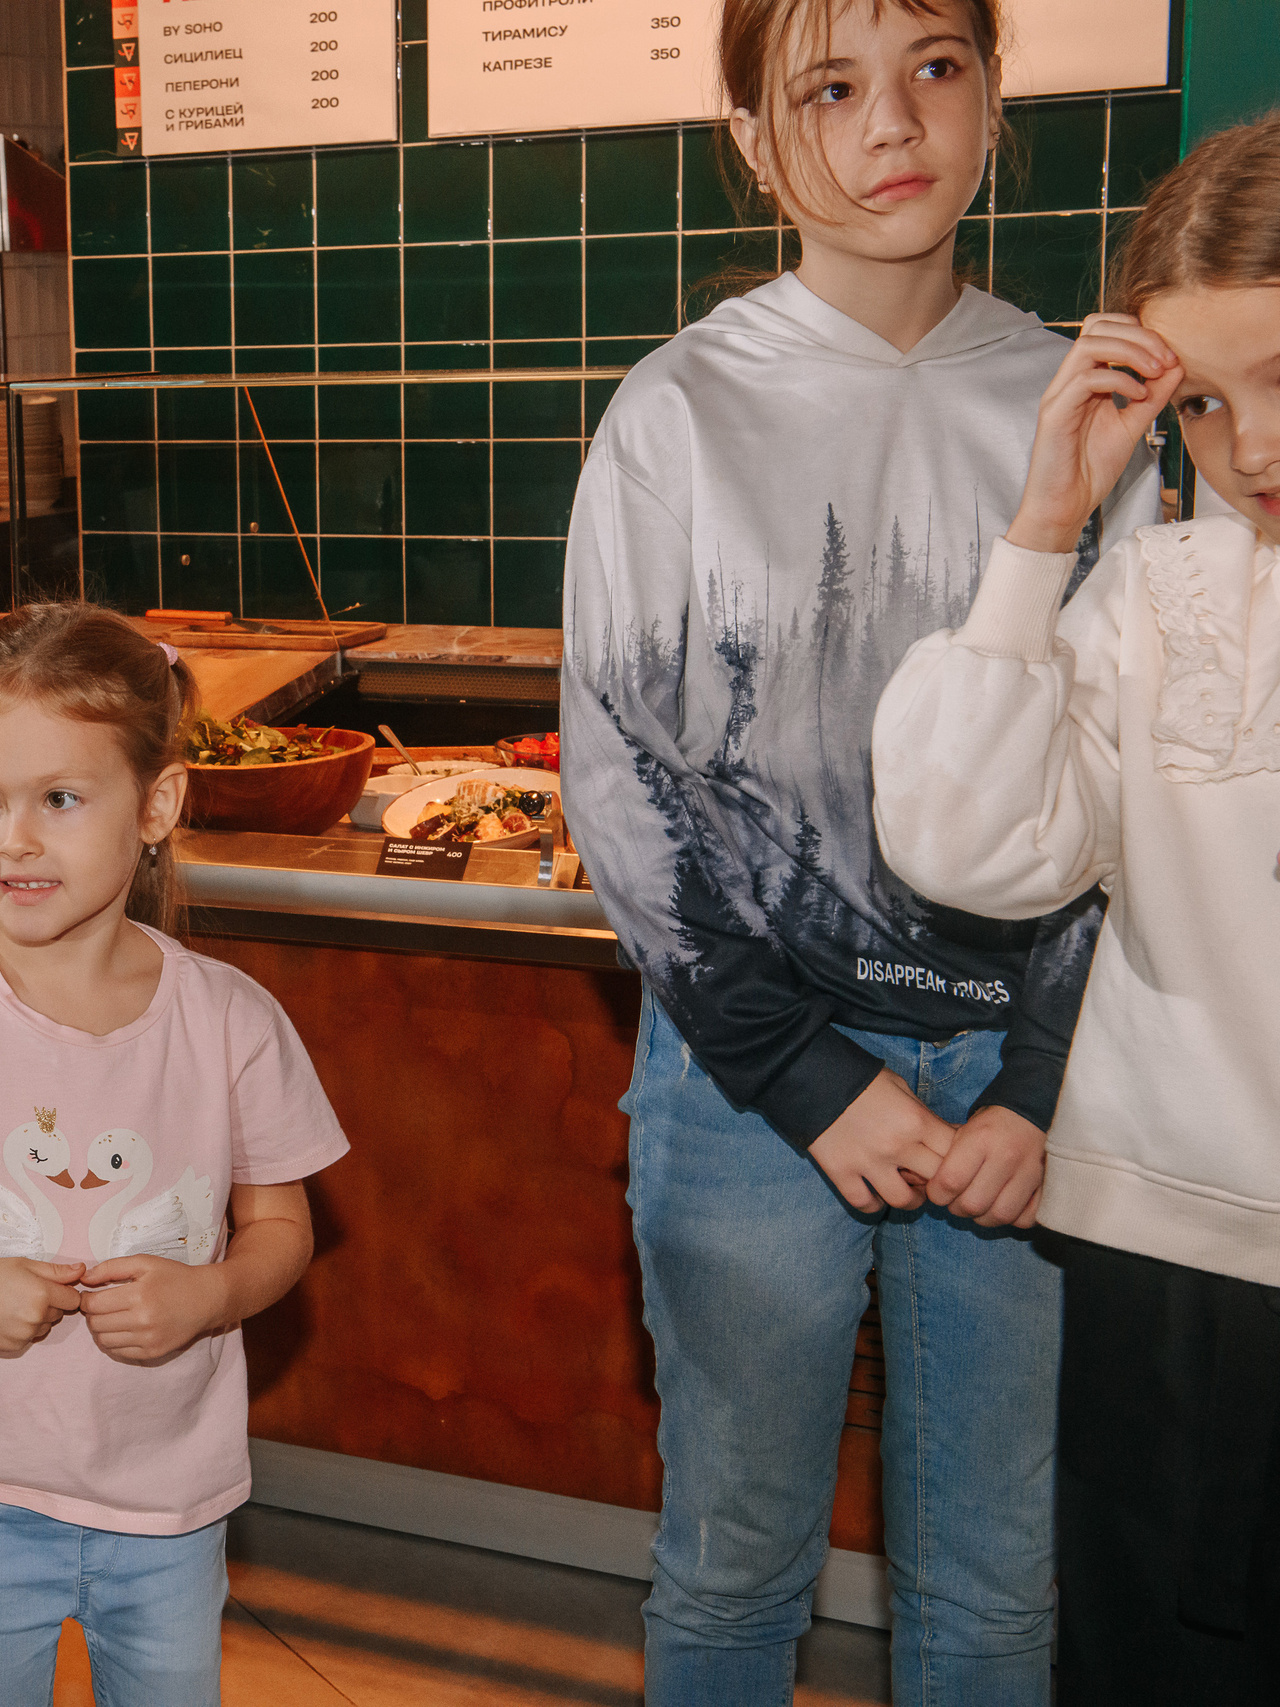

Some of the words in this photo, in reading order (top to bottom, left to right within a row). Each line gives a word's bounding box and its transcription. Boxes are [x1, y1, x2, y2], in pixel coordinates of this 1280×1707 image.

[163, 25, 180, 37] BY
[184, 21, 223, 35] SOHO
[309, 11, 338, 24] 200
[482, 25, 568, 42] ТИРАМИСУ
[650, 15, 681, 29] 350
[163, 48, 243, 64] СИЦИЛИЕЦ
[310, 39, 338, 52] 200
[482, 57, 553, 72] КАПРЕЗЕ
[650, 47, 680, 60] 350
[165, 77, 240, 93] ПЕПЕРОНИ
[311, 69, 339, 82] 200
[165, 109, 175, 120] С
[178, 101, 244, 119] КУРИЦЕЙ
[311, 97, 340, 110] 200
[178, 117, 245, 131] ГРИБАМИ
[856, 957, 946, 994] DISAPPEAR
